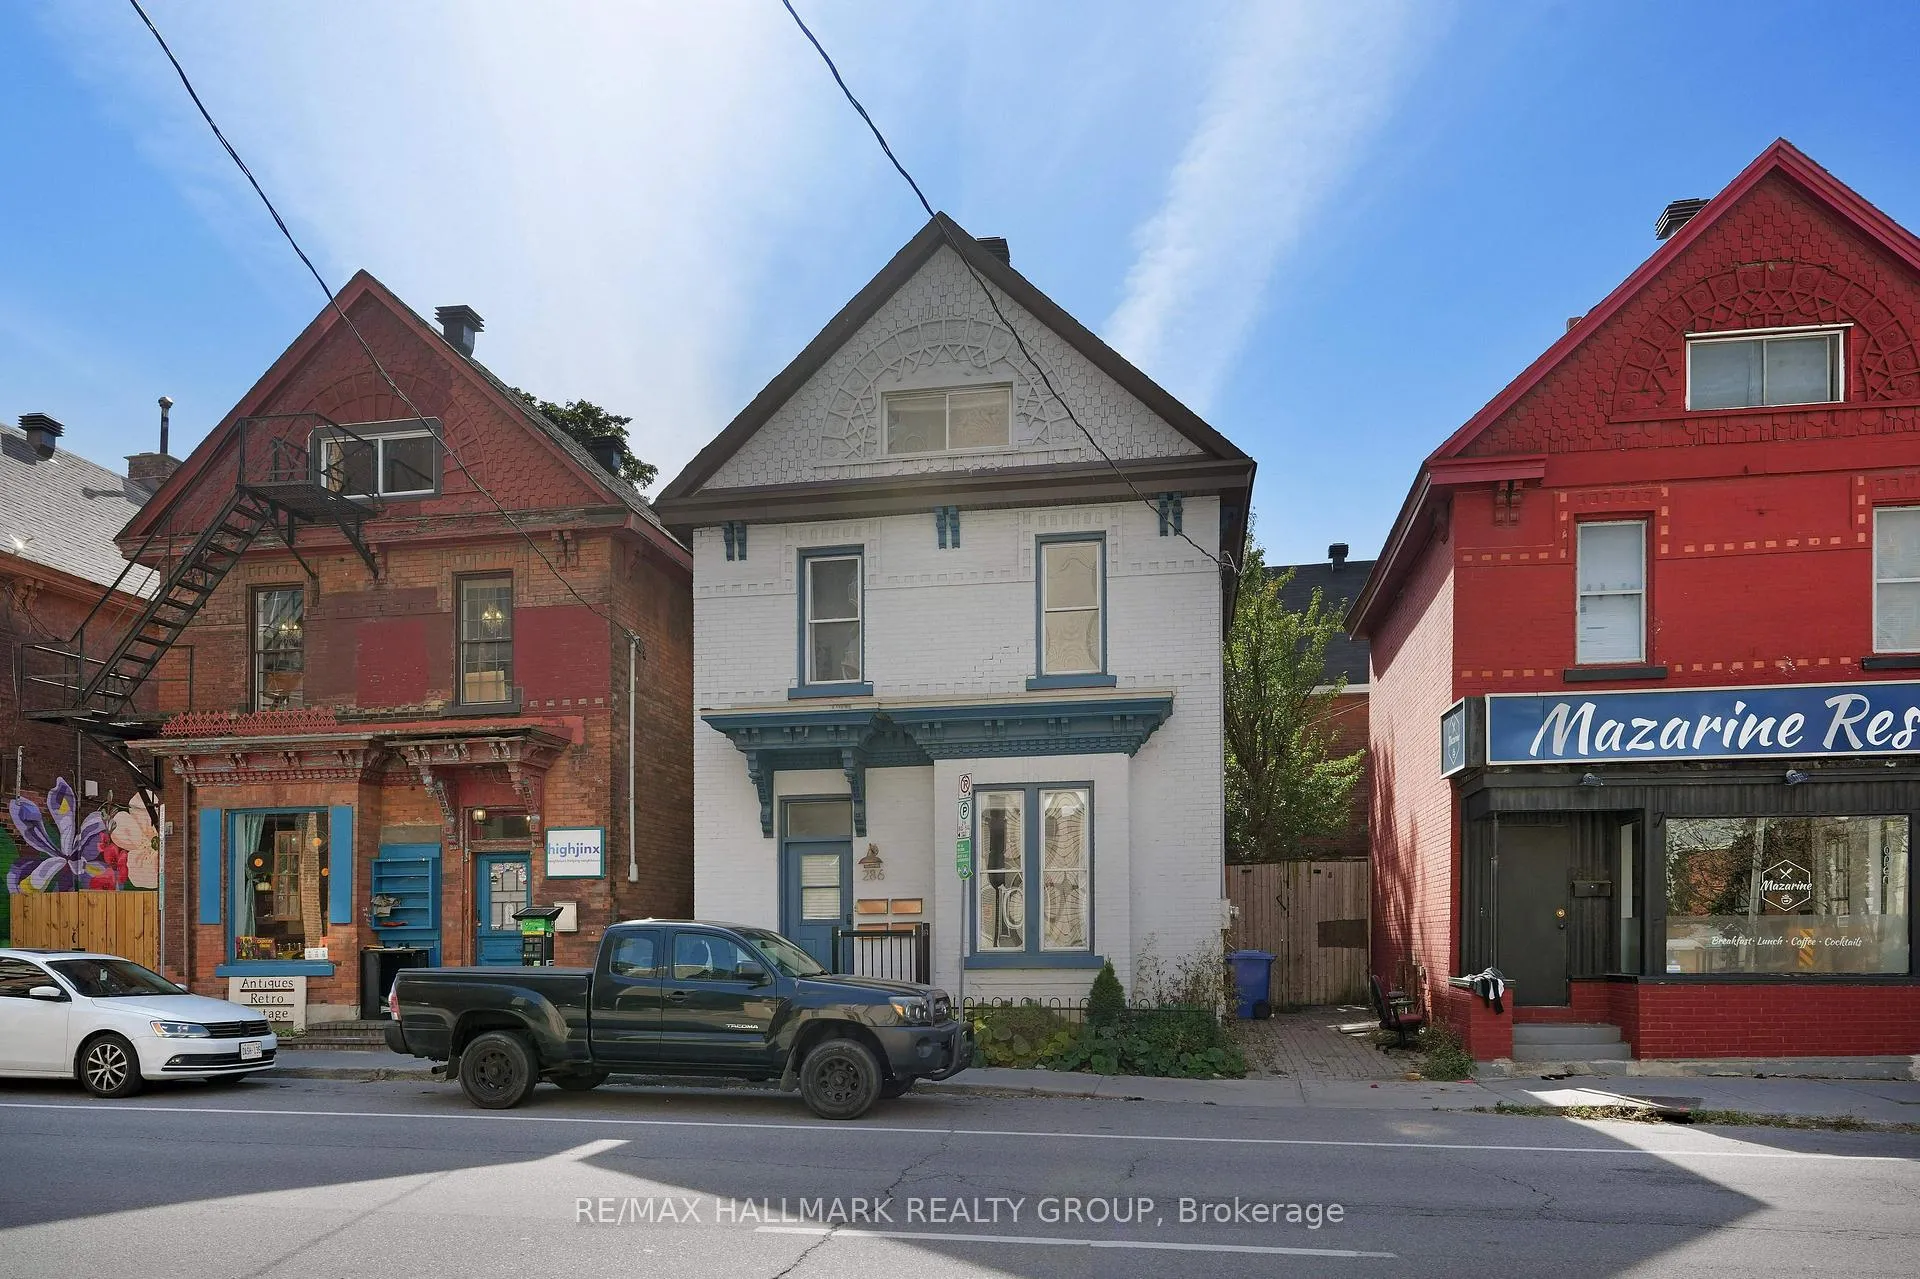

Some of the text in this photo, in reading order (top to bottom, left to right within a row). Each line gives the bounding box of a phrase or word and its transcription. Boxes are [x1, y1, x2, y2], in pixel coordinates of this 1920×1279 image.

[1529, 693, 1920, 757] Mazarine Res
[548, 842, 600, 858] highjinx
[862, 869, 886, 881] 286
[1759, 880, 1813, 892] Mazarine
[1711, 935, 1862, 949] Breakfast Lunch Coffee Cocktails
[241, 978, 294, 989] Antiques
[250, 993, 284, 1004] Retro
[263, 1009, 289, 1020] tage
